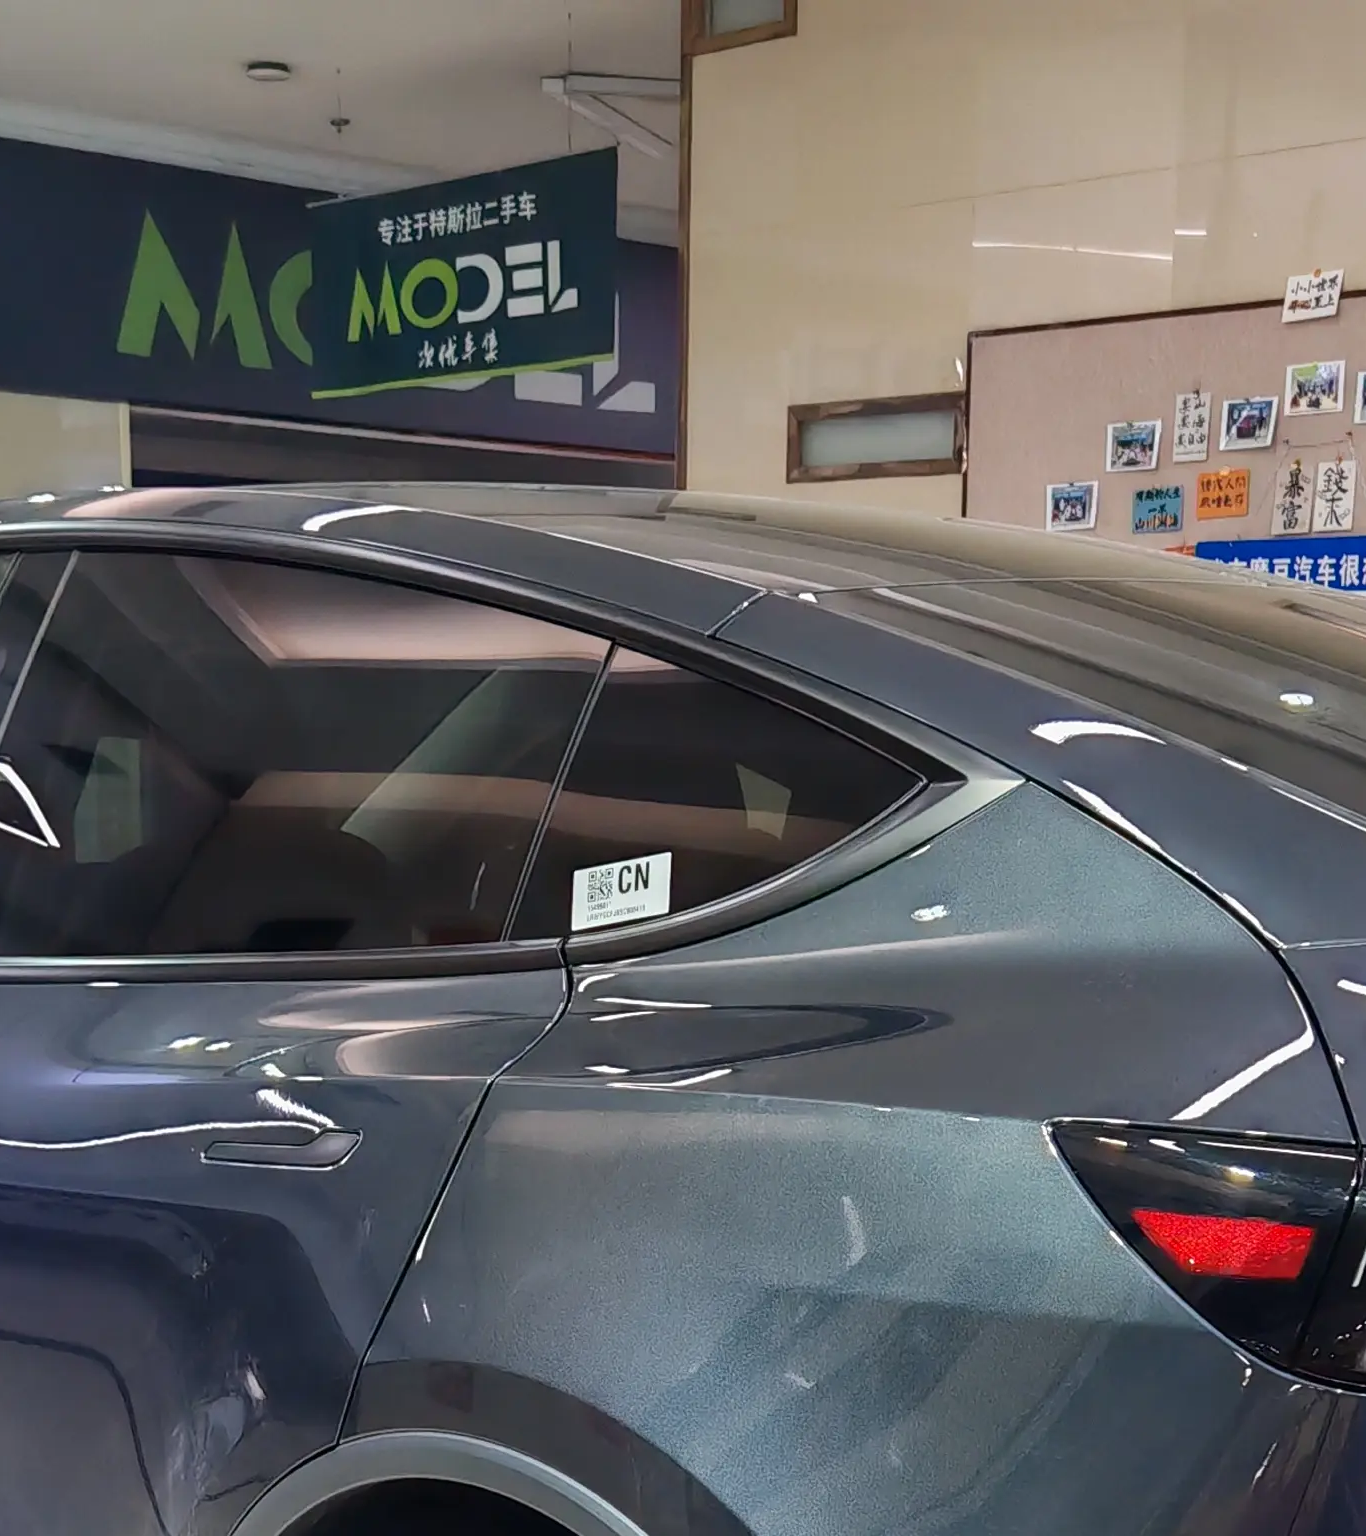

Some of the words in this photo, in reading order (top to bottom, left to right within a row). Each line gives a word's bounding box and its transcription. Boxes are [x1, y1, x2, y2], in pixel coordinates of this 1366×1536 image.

[378, 191, 537, 246] 专注于特斯拉二手车
[348, 240, 578, 342] MODEL
[618, 861, 650, 894] CN
